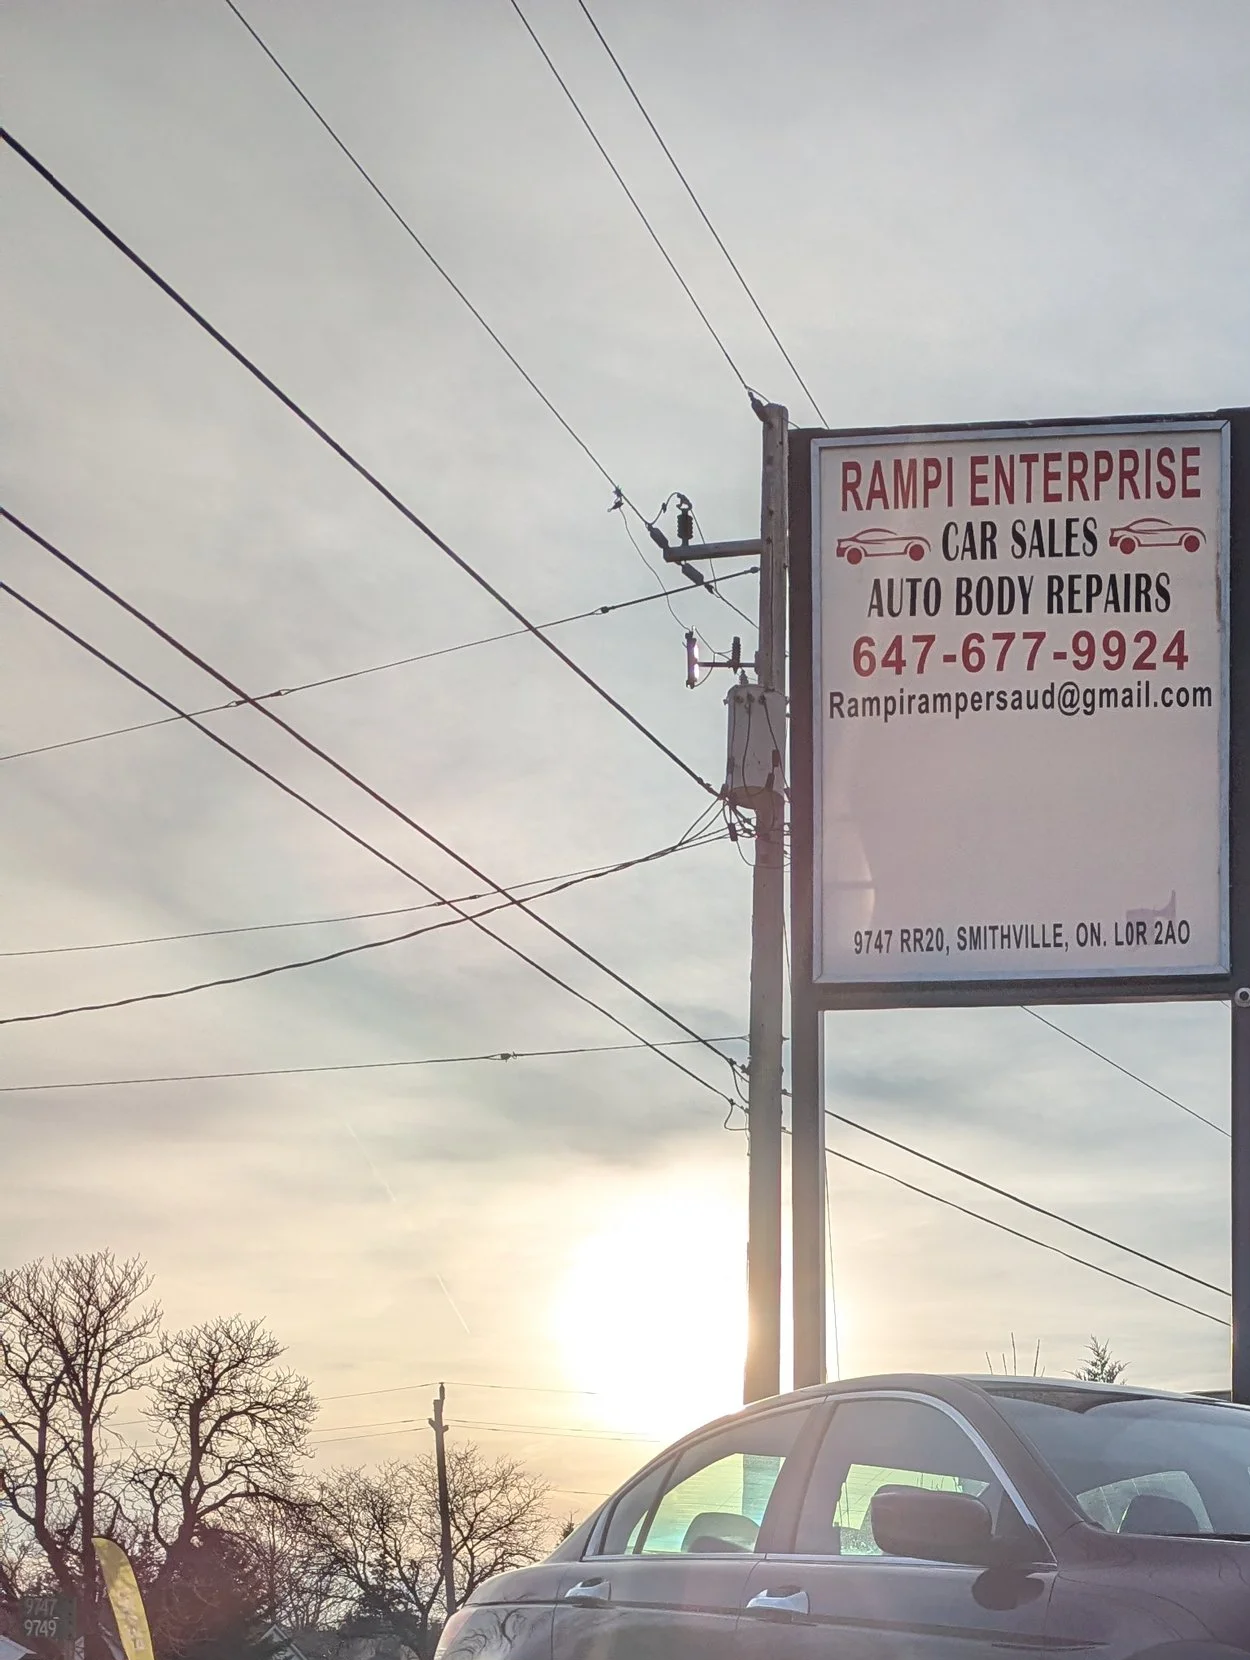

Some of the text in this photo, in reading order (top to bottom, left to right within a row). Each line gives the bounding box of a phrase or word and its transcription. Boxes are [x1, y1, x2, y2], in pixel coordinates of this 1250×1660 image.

[841, 446, 1201, 512] RAMPI ENTERPRISE
[941, 516, 1098, 562] CAR SALES
[867, 572, 1171, 618] AUTO BODY REPAIRS
[852, 629, 1189, 677] 647-677-9924
[829, 680, 1212, 723] Rampirampersaud@gmail.com
[854, 929, 893, 955] 9747
[900, 926, 950, 956] RR20,
[956, 922, 1069, 953] SMITHVILLE,
[1076, 922, 1107, 948] ON.
[24, 1619, 57, 1637] 9749
[25, 1598, 58, 1616] 9747
